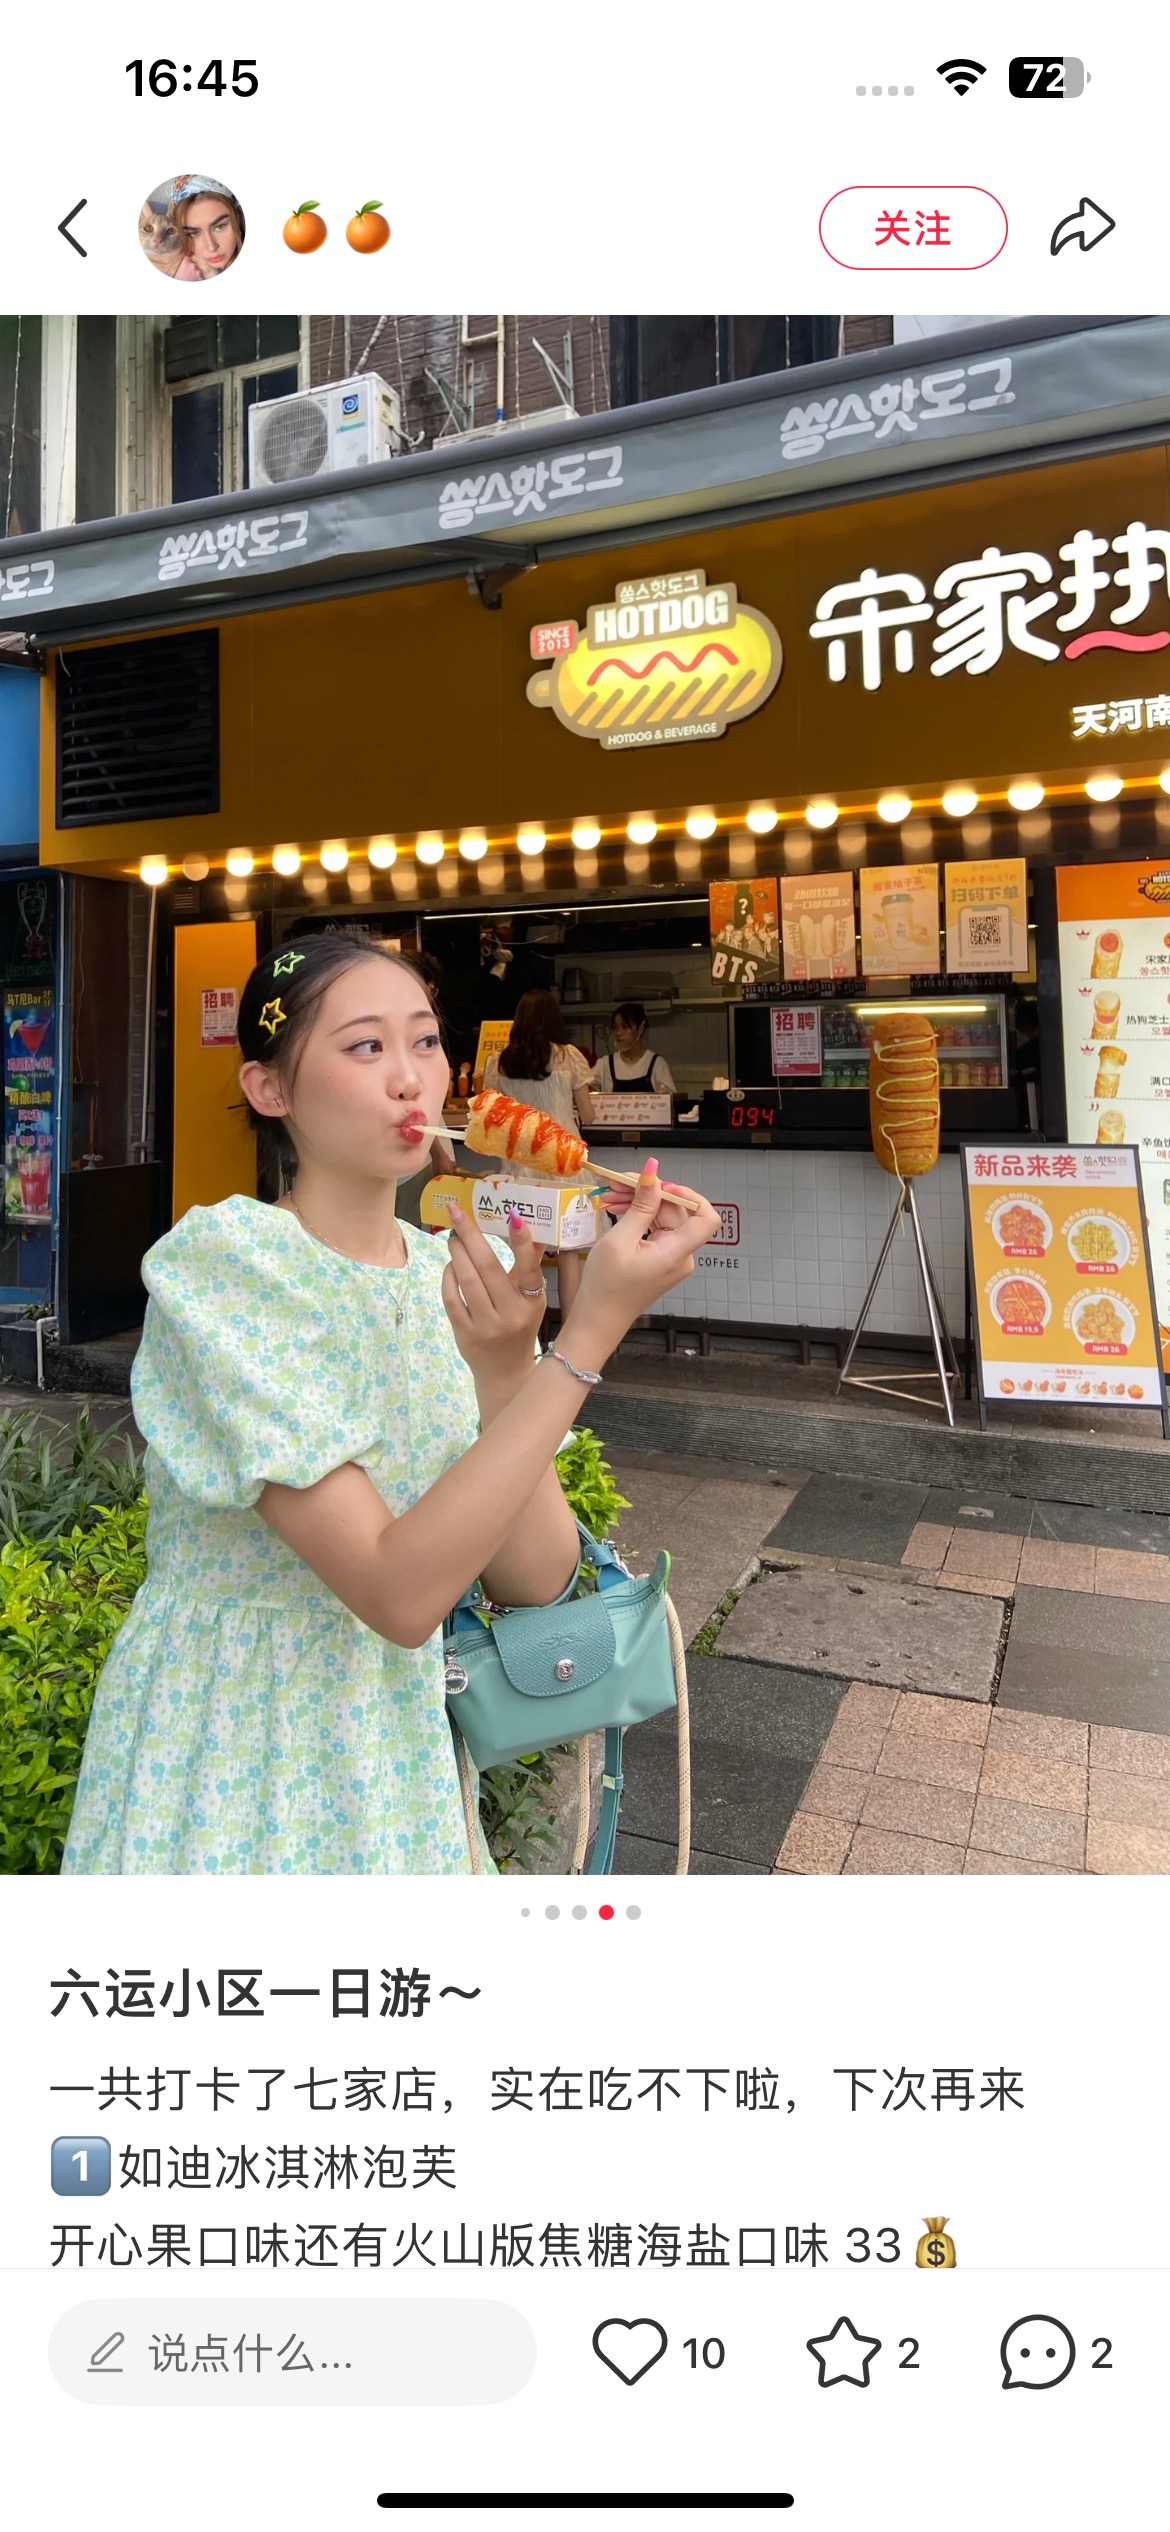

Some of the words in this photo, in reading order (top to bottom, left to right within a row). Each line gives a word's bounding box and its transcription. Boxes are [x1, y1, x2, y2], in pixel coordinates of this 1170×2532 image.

[780, 357, 1016, 460] 쏭스핫도그
[438, 446, 624, 530] 쏭스핫도그
[158, 510, 309, 581] 쏭스핫도그
[0, 559, 54, 601] 도그
[619, 574, 700, 604] 쏭스핫도그
[594, 589, 729, 643] HOTDOG
[537, 626, 570, 641] SINCE
[538, 638, 571, 653] 2013
[1072, 694, 1170, 738] 天河南
[608, 730, 653, 745] HOTDOG
[654, 729, 663, 740] &
[664, 722, 717, 738] BEVERAGE
[951, 885, 1020, 902] 扫码下单
[712, 951, 758, 983] BTS
[1145, 954, 1170, 965] 宋家
[204, 992, 234, 1009] 招聘
[775, 1013, 816, 1031] 招聘
[732, 1107, 774, 1126] 094
[974, 1154, 1078, 1179] 新品来袭
[1011, 1247, 1027, 1256] RMB
[1027, 1248, 1037, 1256] 26
[1007, 1325, 1023, 1333] RMB
[1092, 1345, 1109, 1353] RMB
